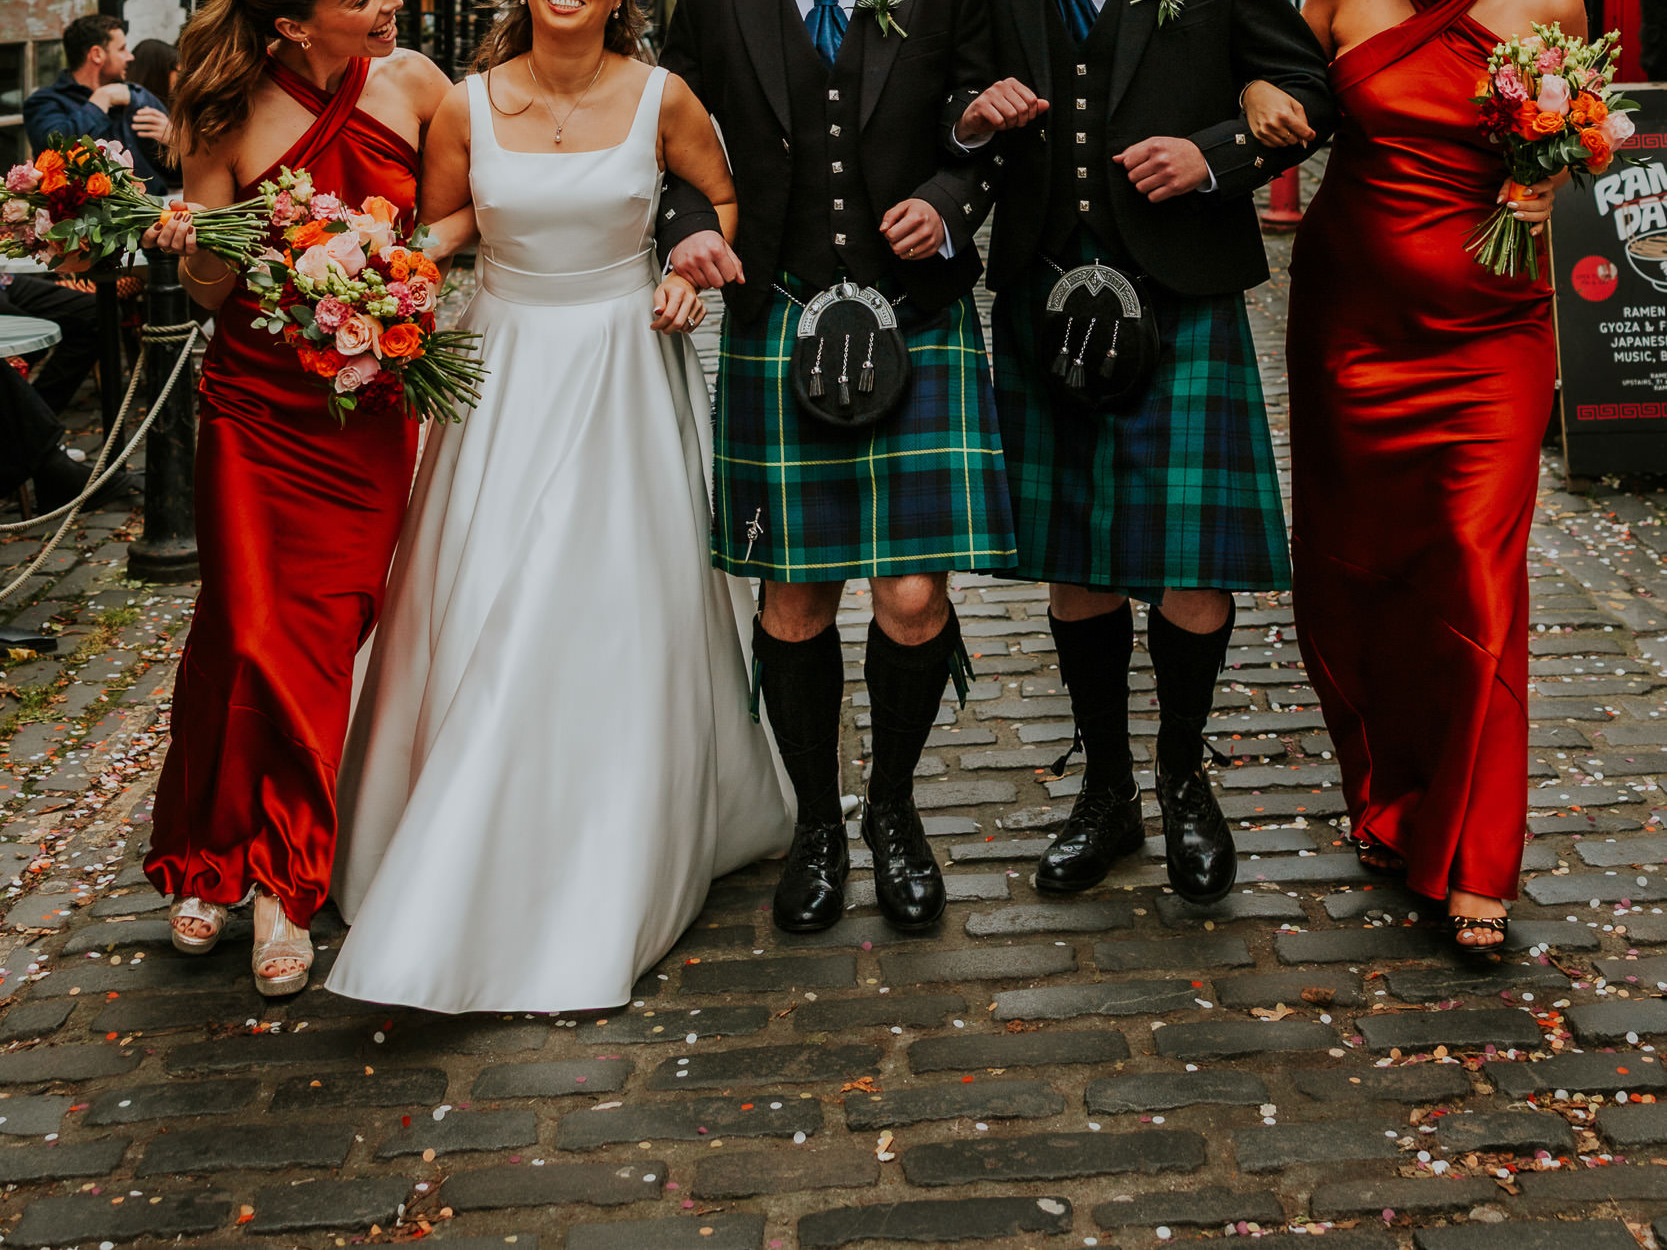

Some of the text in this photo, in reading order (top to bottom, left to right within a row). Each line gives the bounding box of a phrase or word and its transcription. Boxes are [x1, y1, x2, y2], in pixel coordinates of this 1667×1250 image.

[1614, 196, 1667, 241] DA
[1623, 306, 1666, 318] RAMEN
[1599, 321, 1641, 333] GYOZA
[1645, 321, 1655, 332] &
[1614, 351, 1656, 363] MUSIC,
